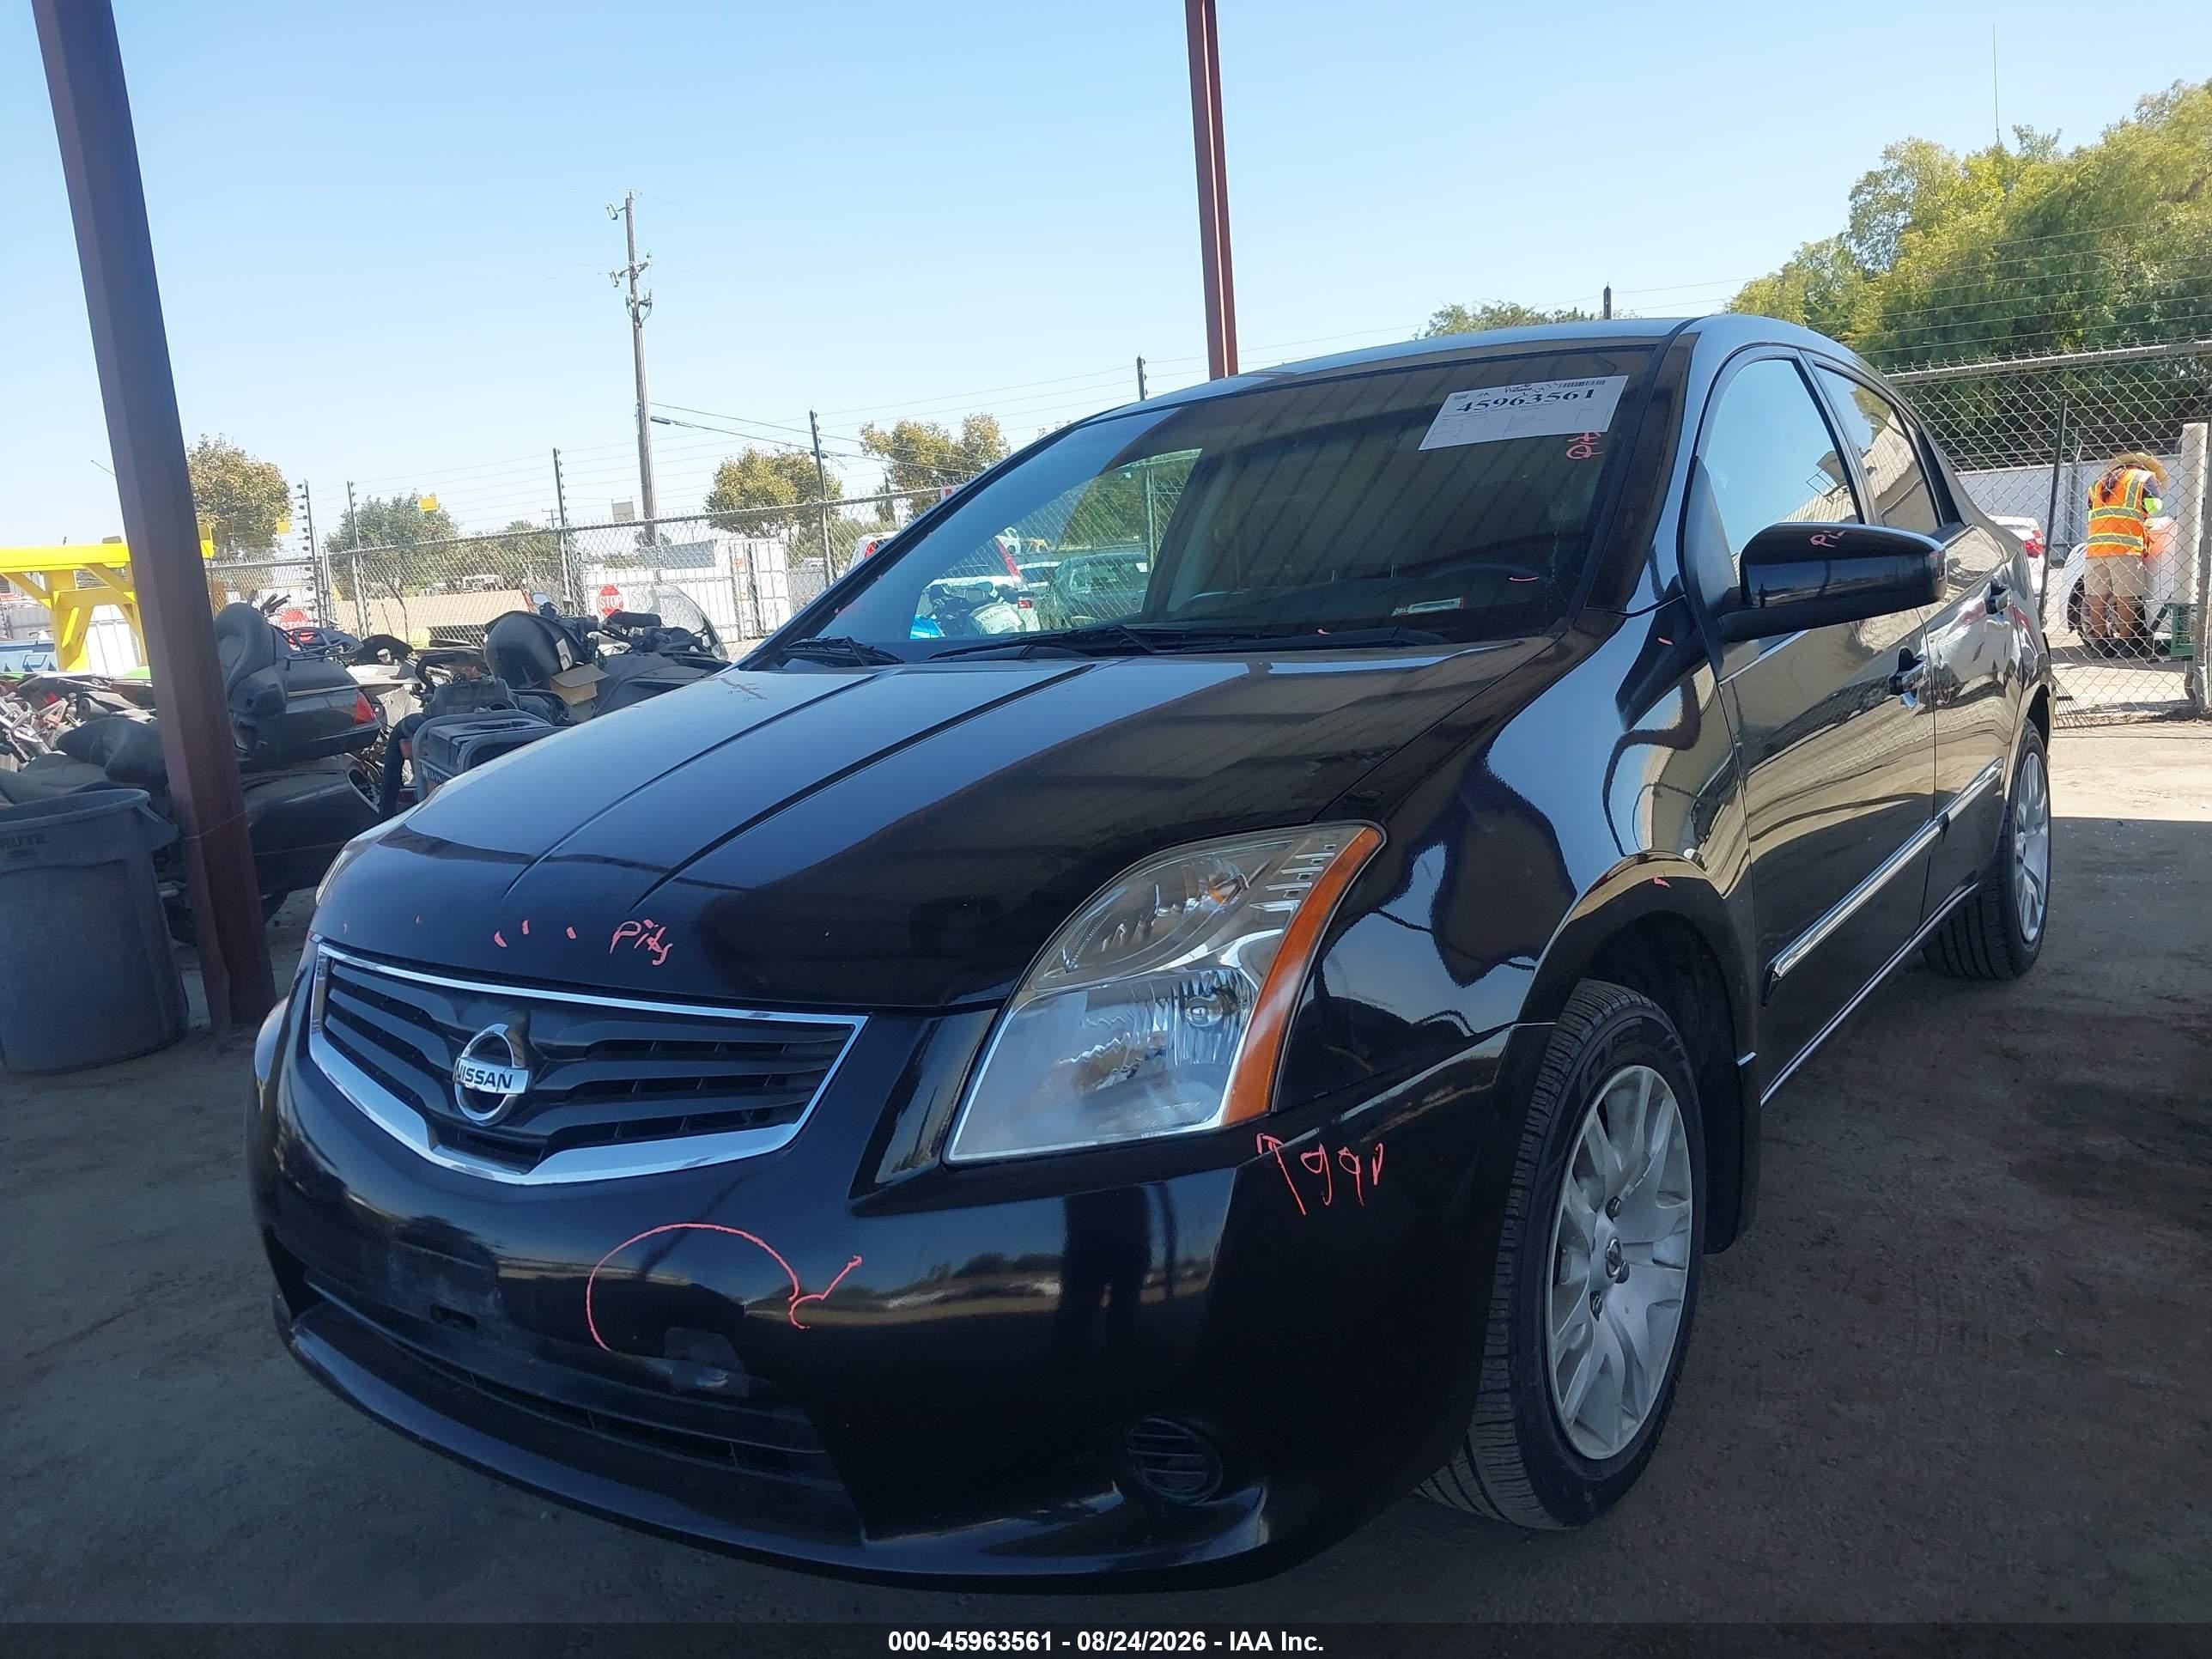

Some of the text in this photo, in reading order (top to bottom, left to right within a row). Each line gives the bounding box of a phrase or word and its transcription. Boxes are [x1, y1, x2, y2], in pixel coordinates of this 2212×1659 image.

[1455, 388, 1595, 412] 45963561
[599, 595, 623, 608] STOP
[453, 1060, 514, 1089] NISSAN
